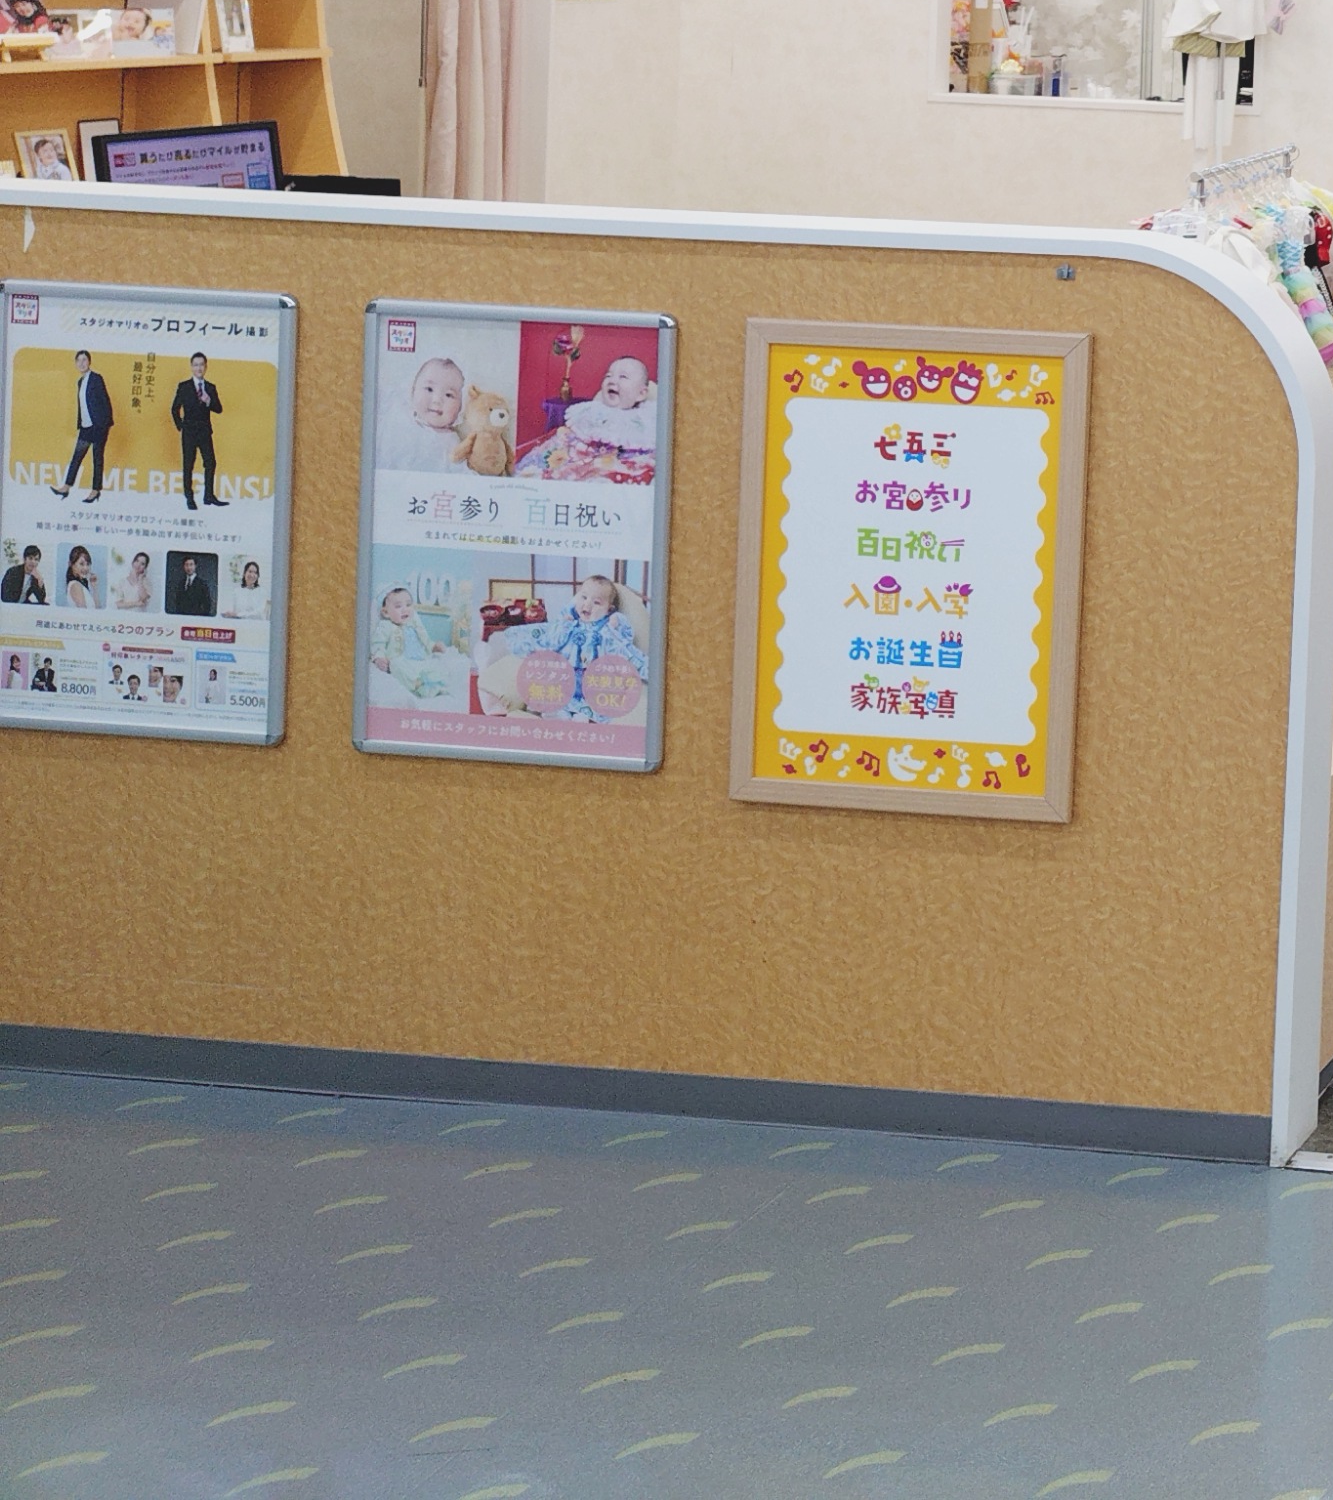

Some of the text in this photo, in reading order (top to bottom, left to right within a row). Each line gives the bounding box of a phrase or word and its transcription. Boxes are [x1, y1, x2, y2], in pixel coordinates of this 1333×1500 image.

[873, 429, 957, 465] 七五三
[407, 490, 622, 528] お宮参り 百日祝い
[854, 479, 972, 512] お宮参り
[856, 526, 965, 563] 百日祝い
[843, 578, 972, 620] 入園・入学
[849, 632, 964, 669] お誕生日
[596, 693, 626, 708] OK!
[850, 680, 956, 719] 家族写真
